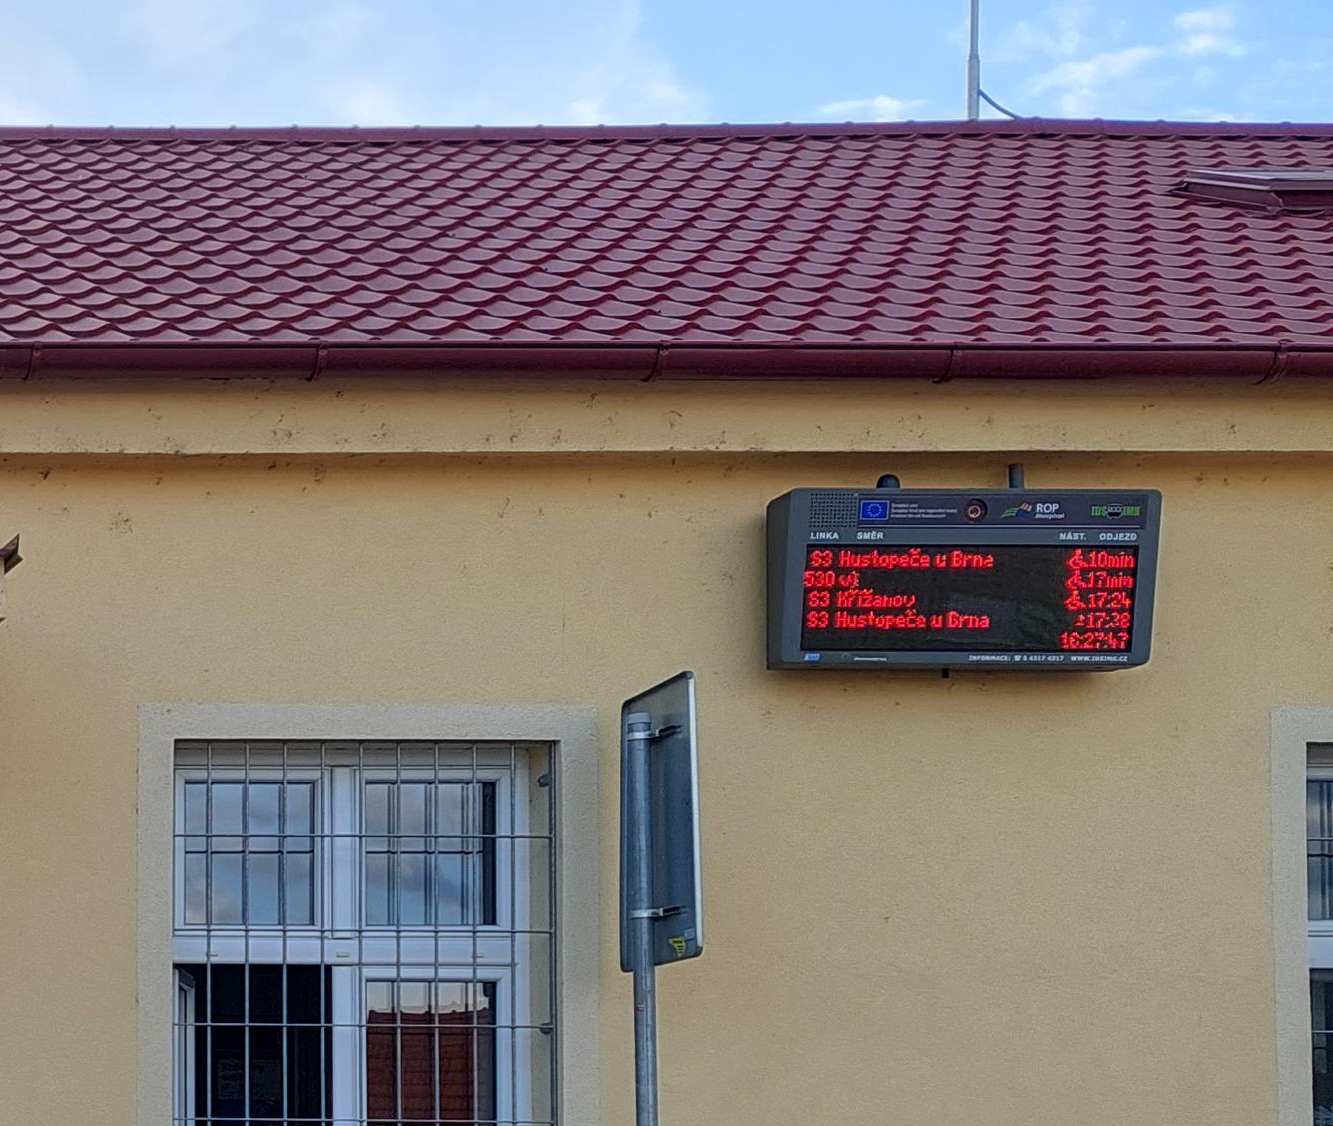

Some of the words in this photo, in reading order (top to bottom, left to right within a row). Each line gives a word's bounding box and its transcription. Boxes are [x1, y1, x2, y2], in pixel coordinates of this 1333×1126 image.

[1036, 503, 1059, 513] ROP
[810, 531, 839, 540] LINKA
[856, 530, 884, 540] SMĚR
[1099, 532, 1137, 541] ODJEZD
[810, 550, 833, 568] S3
[839, 548, 931, 569] Hustopeče
[934, 553, 946, 568] u
[951, 550, 995, 568] Brna
[804, 571, 835, 588] 530
[808, 592, 831, 608] S3
[806, 611, 829, 628] S3
[835, 609, 926, 630] Hustopeče
[930, 615, 942, 628] u
[947, 611, 990, 629] Brna
